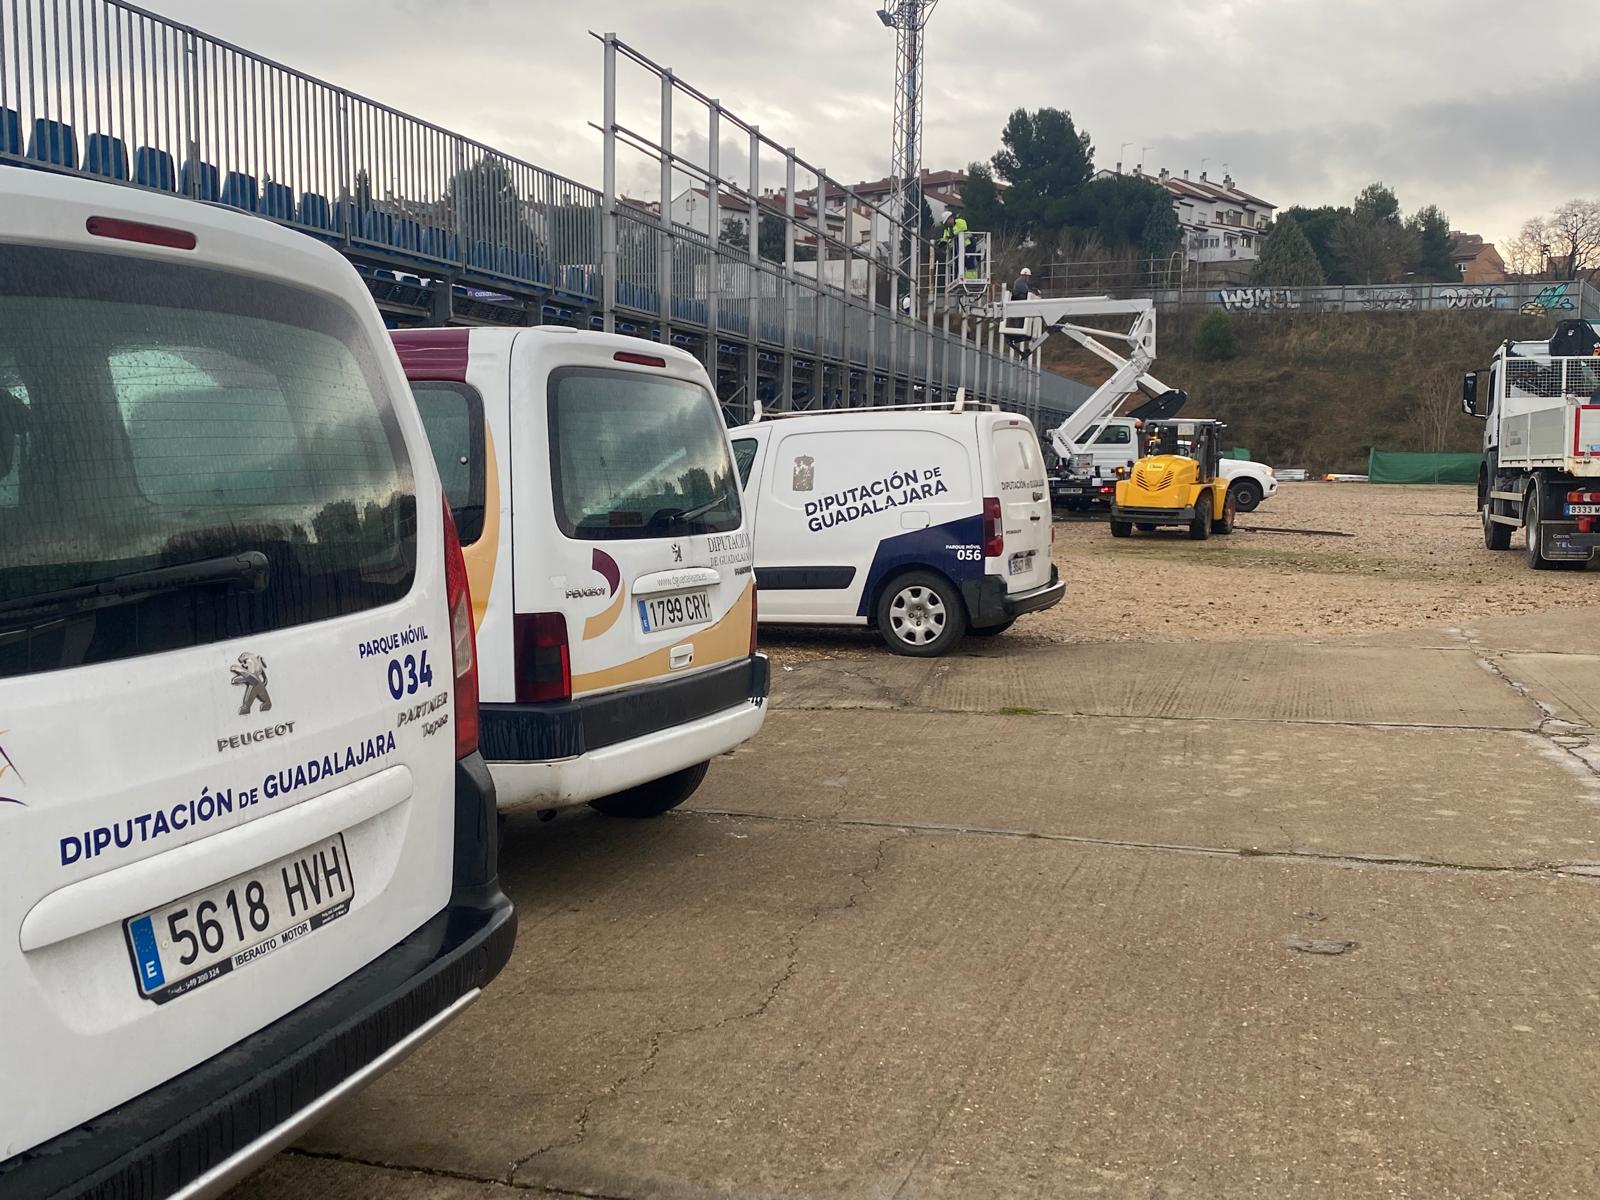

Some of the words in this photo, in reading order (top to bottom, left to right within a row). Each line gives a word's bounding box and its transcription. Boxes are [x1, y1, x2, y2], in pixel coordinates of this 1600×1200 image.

[805, 470, 918, 518] DIPUTACIÓN
[924, 467, 942, 481] DE
[808, 480, 948, 532] GUADALAJARA
[710, 556, 719, 567] DE
[957, 550, 981, 560] 056
[650, 598, 683, 627] 1799
[685, 594, 708, 620] CRY
[359, 634, 400, 658] PARQUE
[401, 624, 428, 646] MÓVIL
[388, 650, 432, 700] 034
[397, 692, 448, 728] PARTNER
[217, 721, 295, 752] PEUGEOT
[60, 786, 233, 866] DIPUTACIÓN
[239, 787, 259, 809] DE
[264, 731, 396, 799] GUADALAJARA
[168, 880, 270, 965] 5618
[282, 846, 346, 917] HVH
[235, 941, 276, 966] IBERAUTO
[281, 923, 308, 942] MOTOR
[146, 961, 157, 978] E
[197, 972, 208, 984] 200
[208, 967, 220, 978] 324
